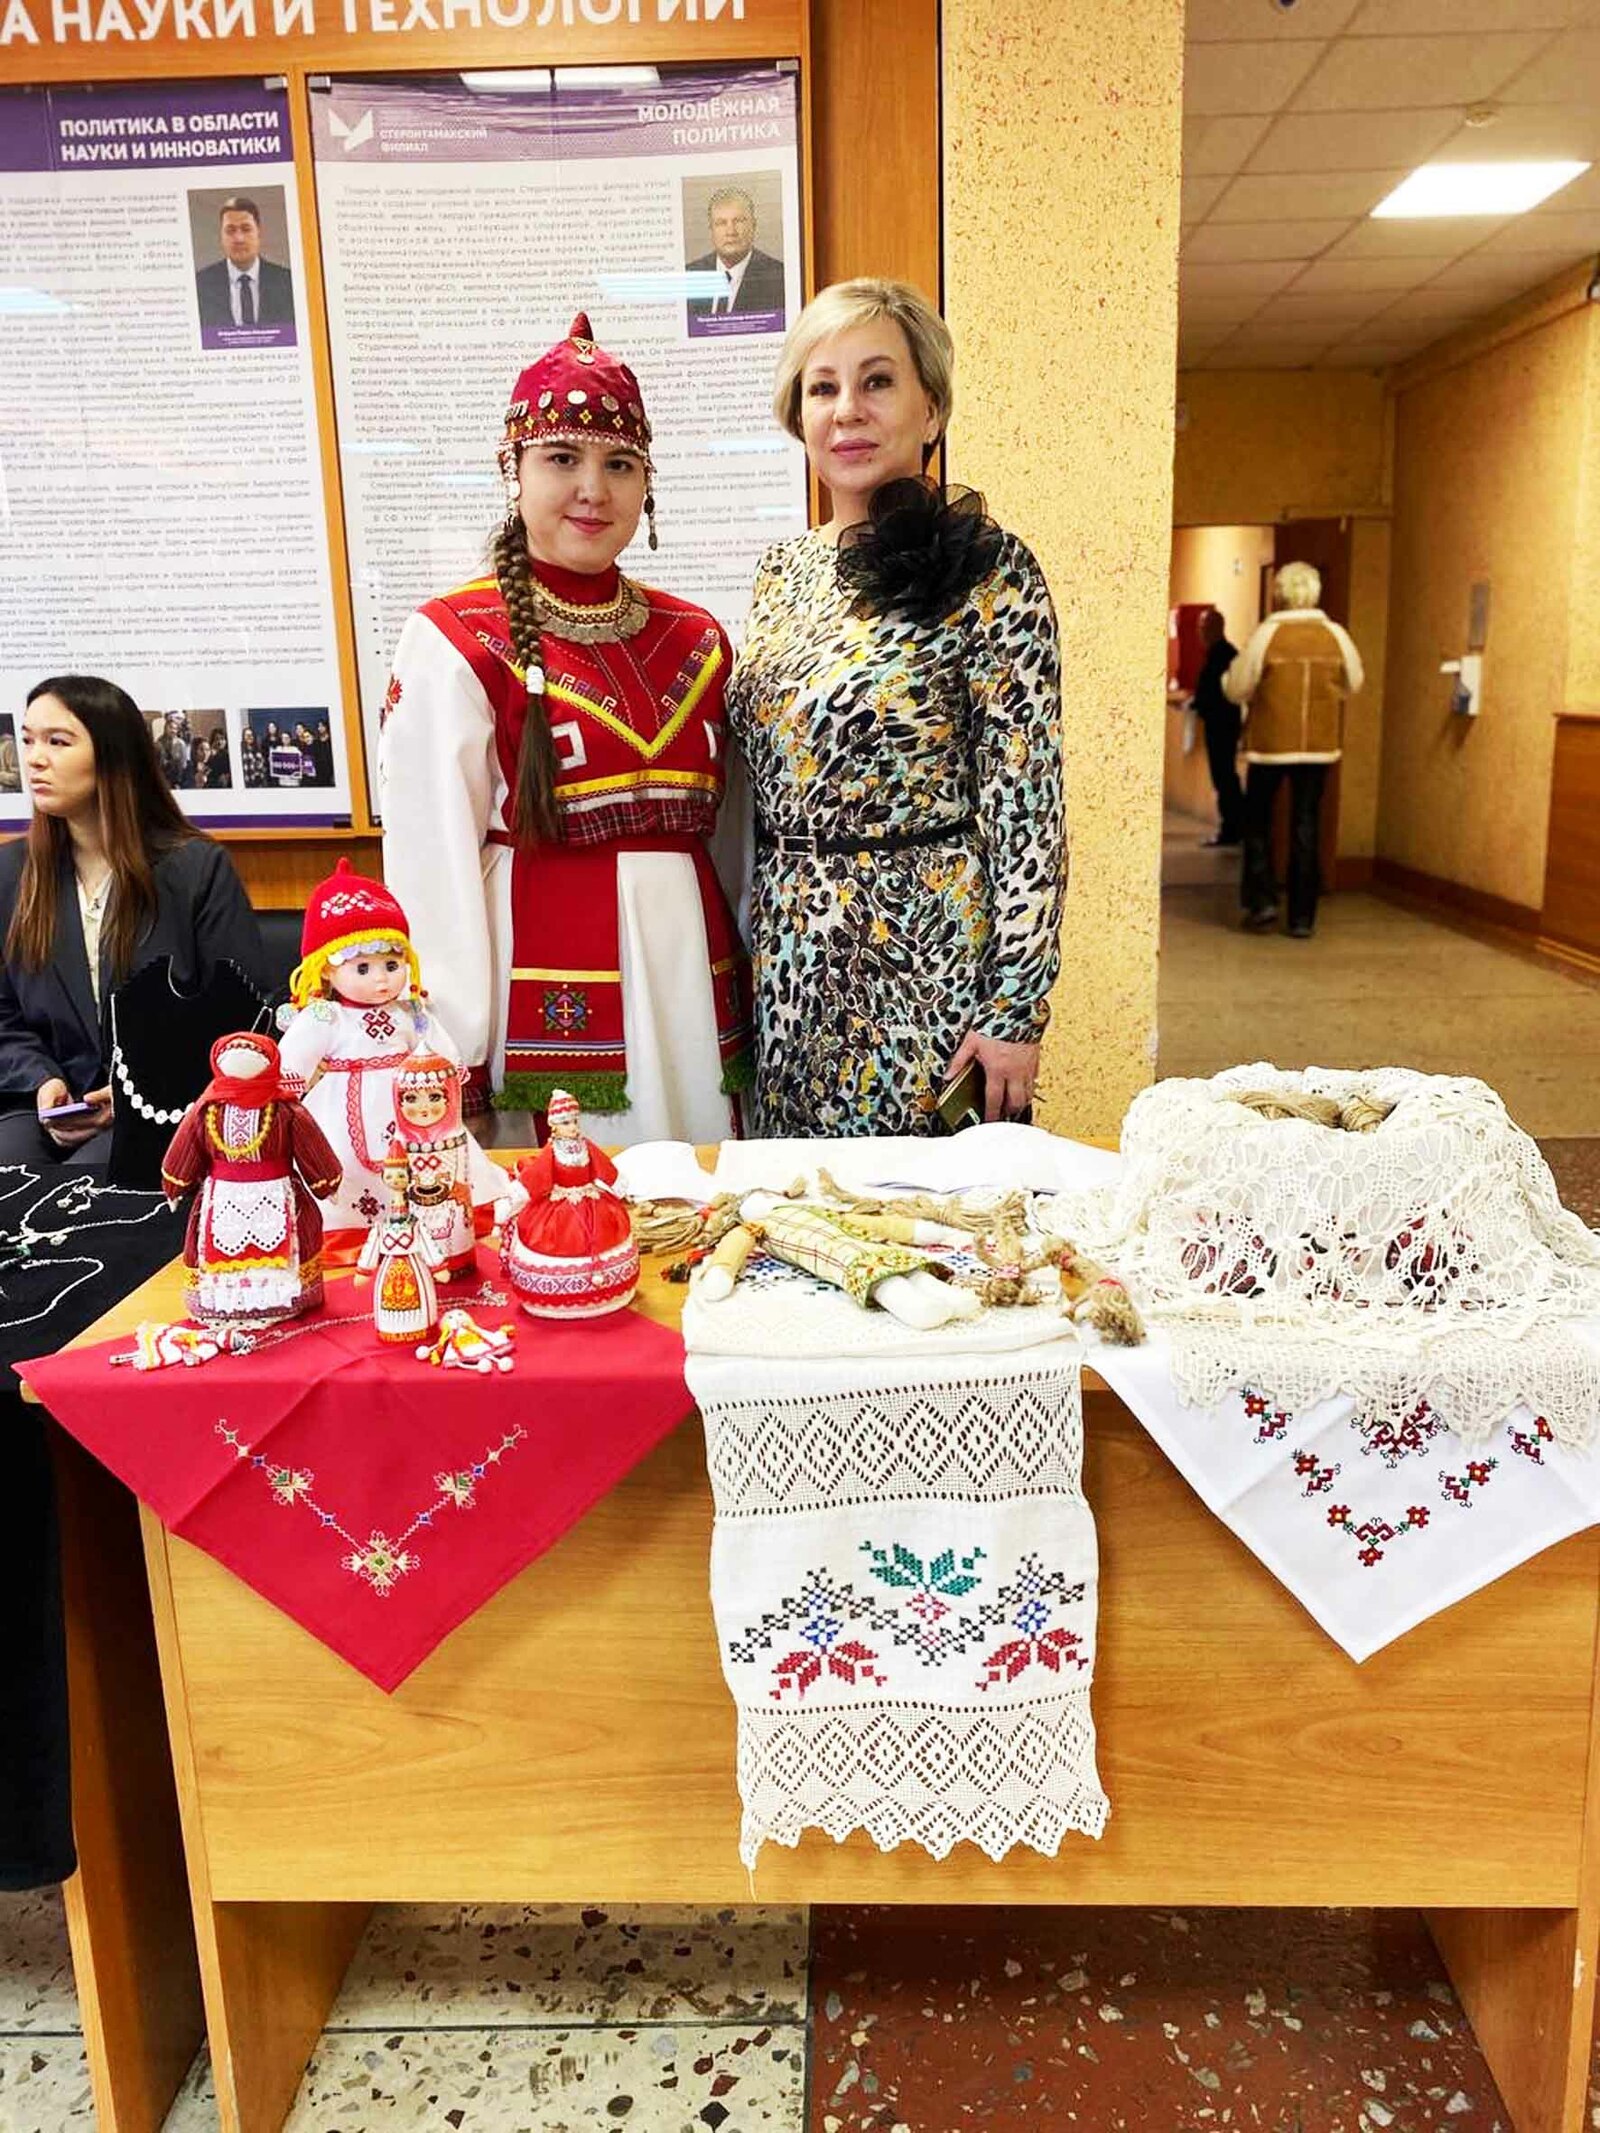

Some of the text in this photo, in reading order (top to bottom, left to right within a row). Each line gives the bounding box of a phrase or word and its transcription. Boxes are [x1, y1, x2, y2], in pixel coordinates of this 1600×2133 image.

[51, 0, 257, 43] НАУКИ
[271, 0, 315, 35] И
[637, 96, 779, 122] МОЛОДЁЖНАЯ
[59, 111, 279, 137] ПОЛИТИКА В ОБЛАСТИ
[379, 127, 488, 140] СТЕРЛИТАМАКСКИЙ
[672, 123, 780, 145] ПОЛИТИКА
[61, 136, 281, 162] НАУКИ И ИННОВАТИКИ
[381, 142, 429, 153] ФИЛИАЛ
